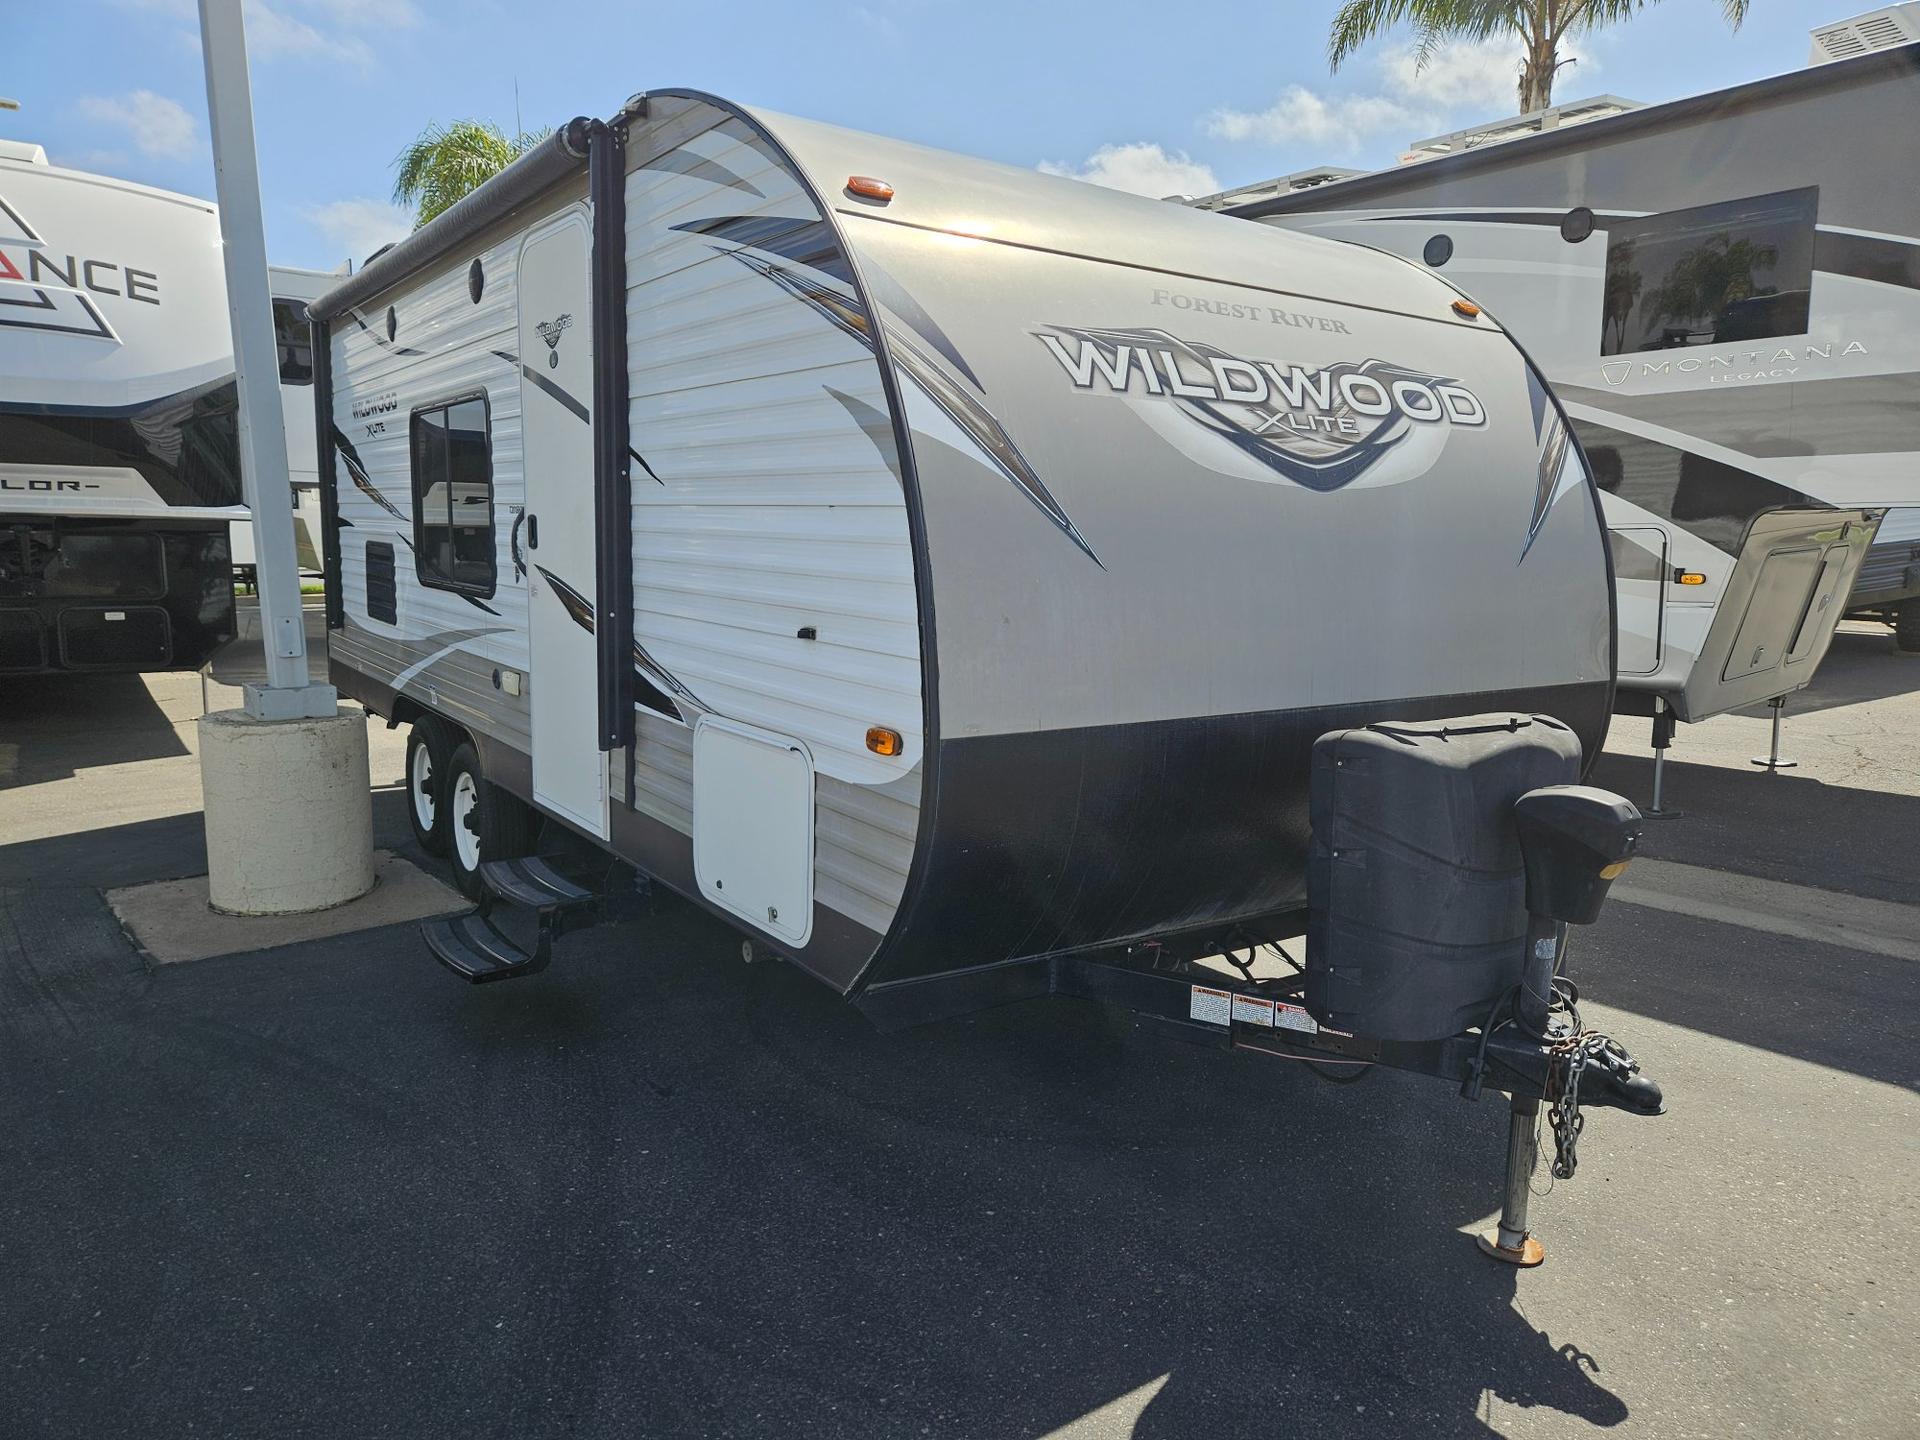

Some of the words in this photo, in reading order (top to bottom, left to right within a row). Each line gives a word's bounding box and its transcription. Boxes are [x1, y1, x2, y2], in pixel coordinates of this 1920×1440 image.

[1150, 288, 1261, 321] FOREST
[1268, 307, 1352, 335] RIVER
[1641, 341, 1869, 376] MONTANA
[1710, 367, 1799, 383] LEGACY
[1033, 332, 1487, 426] WILDWOOD
[1247, 407, 1360, 438] XLITE
